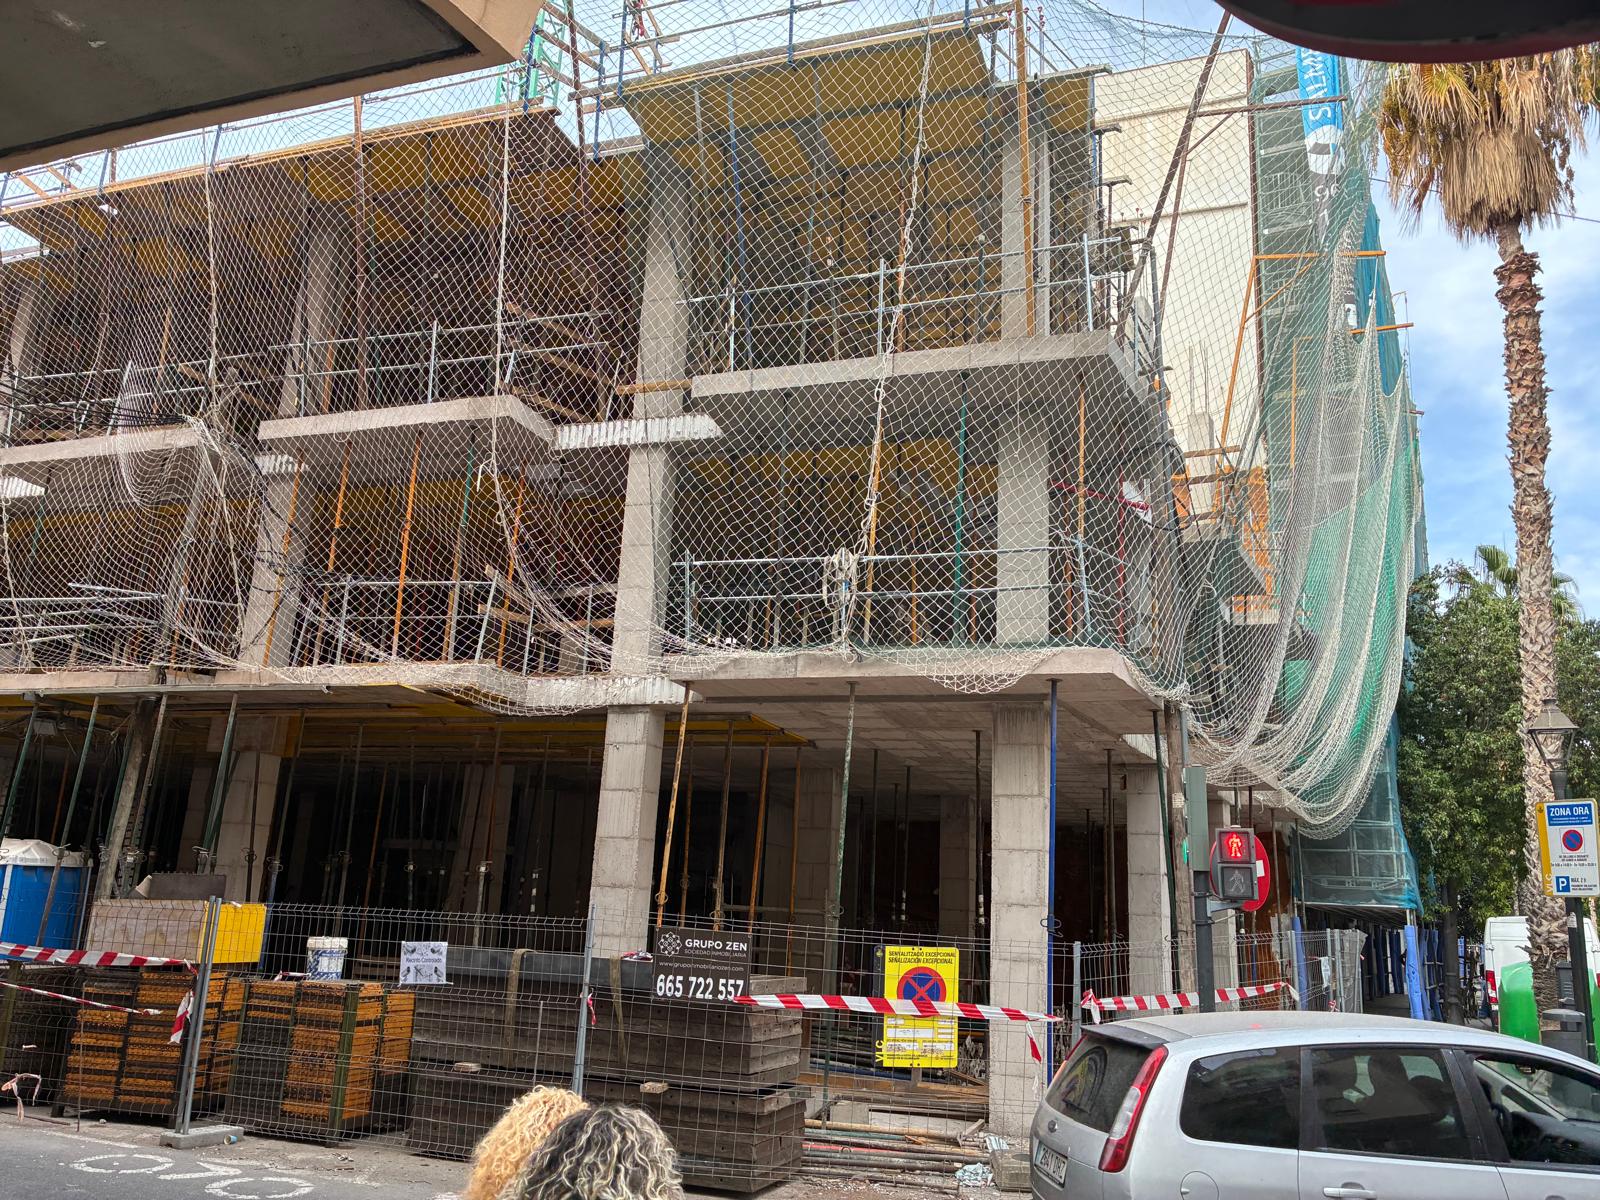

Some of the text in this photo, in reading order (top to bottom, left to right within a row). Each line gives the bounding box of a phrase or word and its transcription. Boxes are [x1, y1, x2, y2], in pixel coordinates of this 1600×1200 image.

[1550, 806, 1590, 816] ZONA ORA
[1559, 877, 1567, 891] P
[685, 939, 747, 951] GRUPO ZEN
[711, 950, 747, 958] INMOBILIARIA
[657, 974, 744, 1001] 665 722 557
[875, 1040, 884, 1062] VLC
